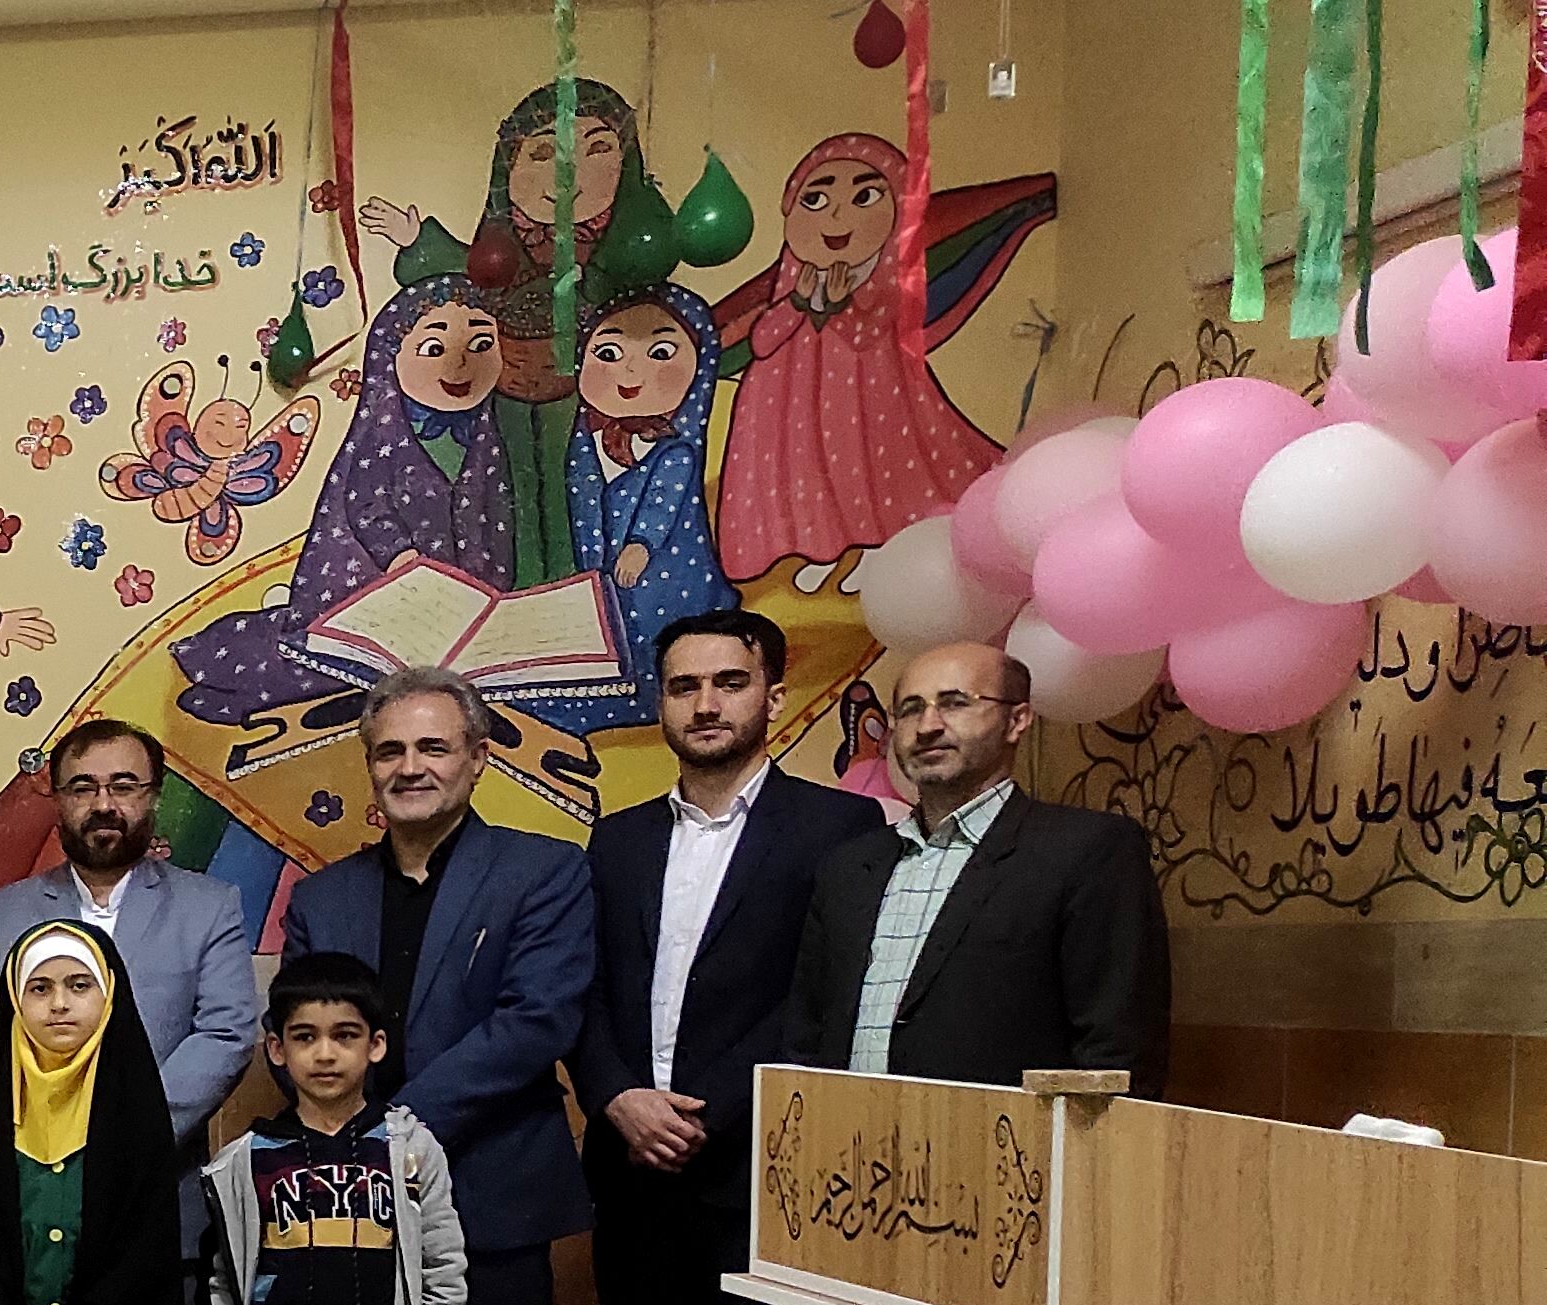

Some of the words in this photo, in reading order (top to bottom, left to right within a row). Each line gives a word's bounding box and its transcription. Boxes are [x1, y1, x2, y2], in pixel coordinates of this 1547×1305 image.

[151, 247, 221, 294] خدا
[270, 1164, 395, 1236] NYC
[884, 1184, 980, 1254] بسم
